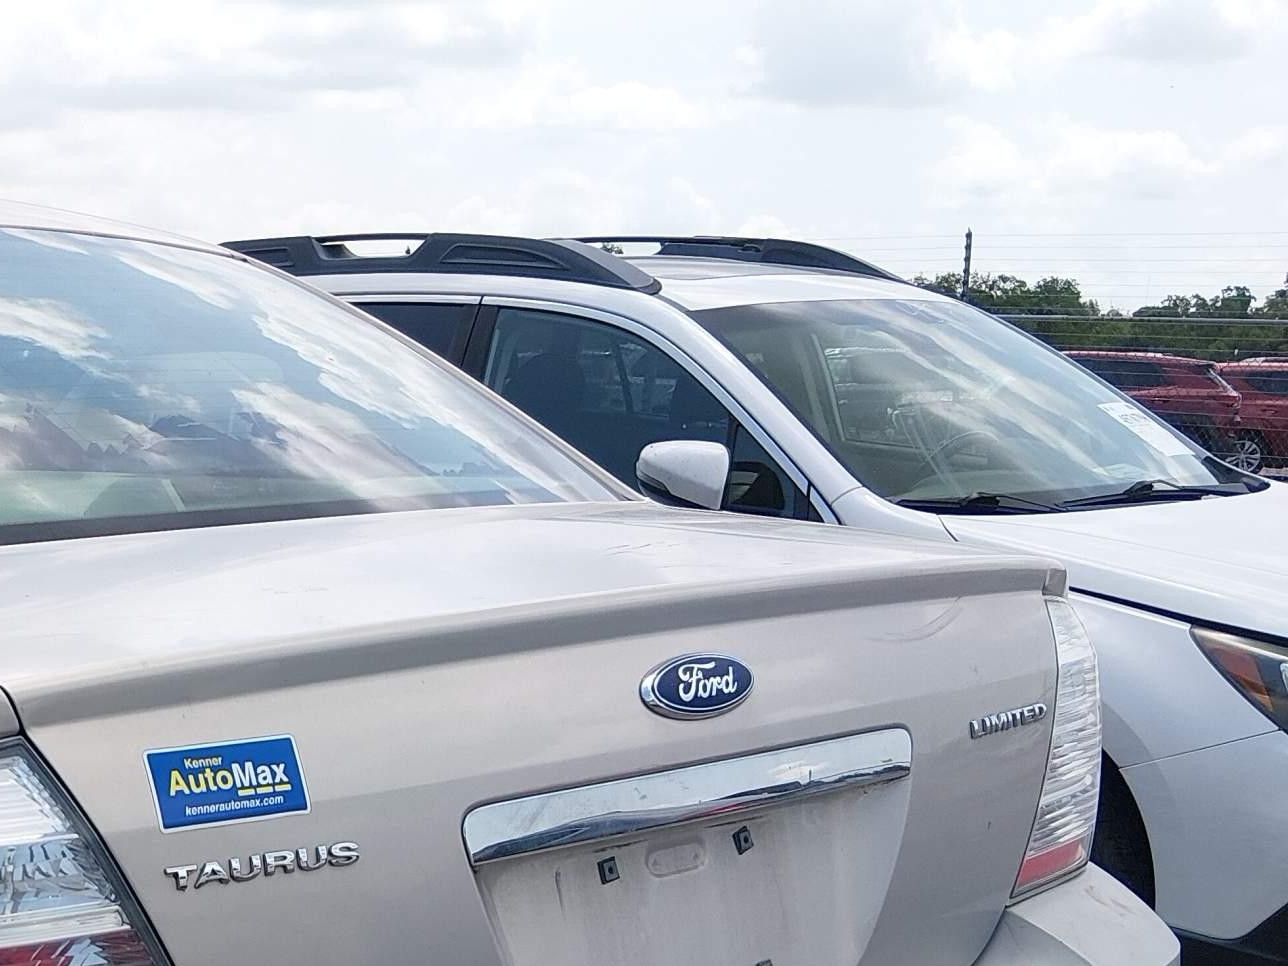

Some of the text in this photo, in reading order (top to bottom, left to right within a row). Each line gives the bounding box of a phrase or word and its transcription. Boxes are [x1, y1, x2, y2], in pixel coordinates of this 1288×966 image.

[678, 661, 738, 702] Ford
[969, 703, 1047, 739] LIMITED
[169, 761, 289, 796] AutoMax
[183, 756, 222, 770] Kenner
[185, 795, 284, 817] kennerautomax.com
[164, 842, 360, 891] TAURUS
